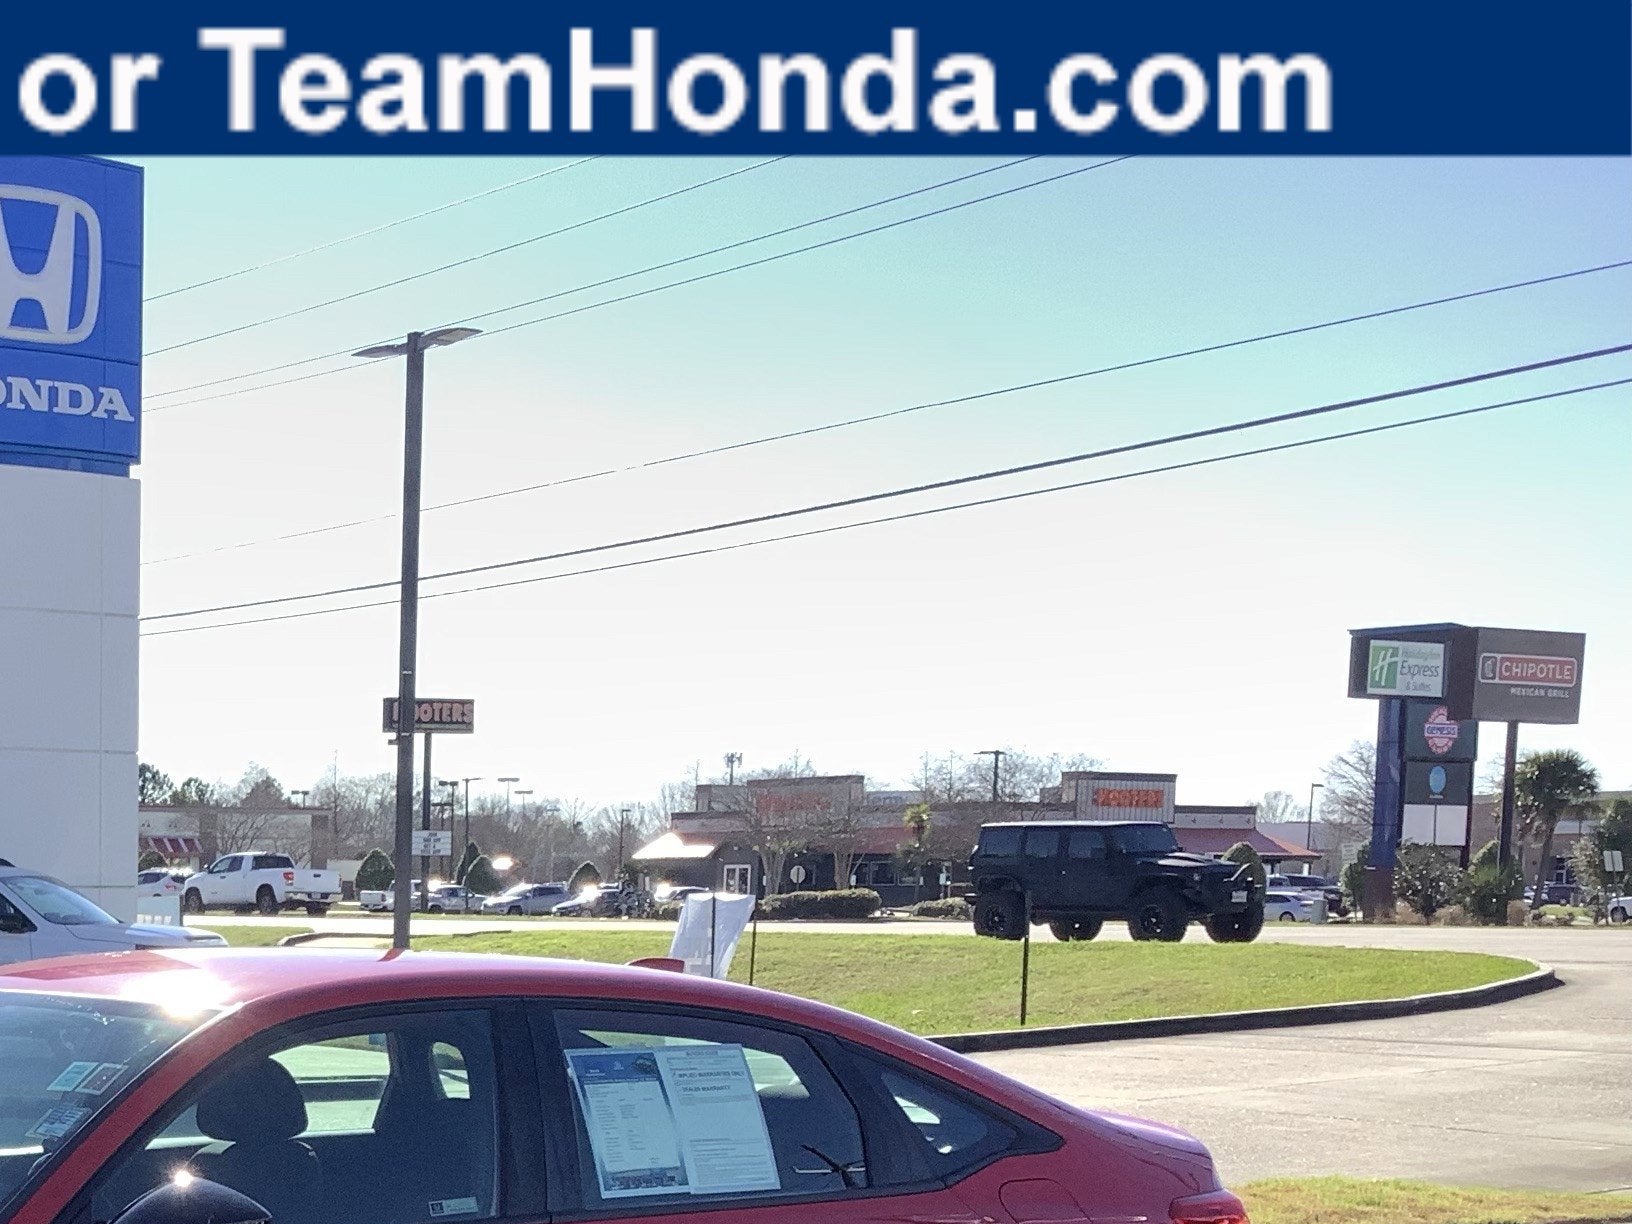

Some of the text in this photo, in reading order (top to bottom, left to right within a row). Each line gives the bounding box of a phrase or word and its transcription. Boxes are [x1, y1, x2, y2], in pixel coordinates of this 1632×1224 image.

[1400, 660, 1440, 680] Express
[1501, 661, 1572, 680] CHIPOTLE
[393, 702, 472, 722] OTERS
